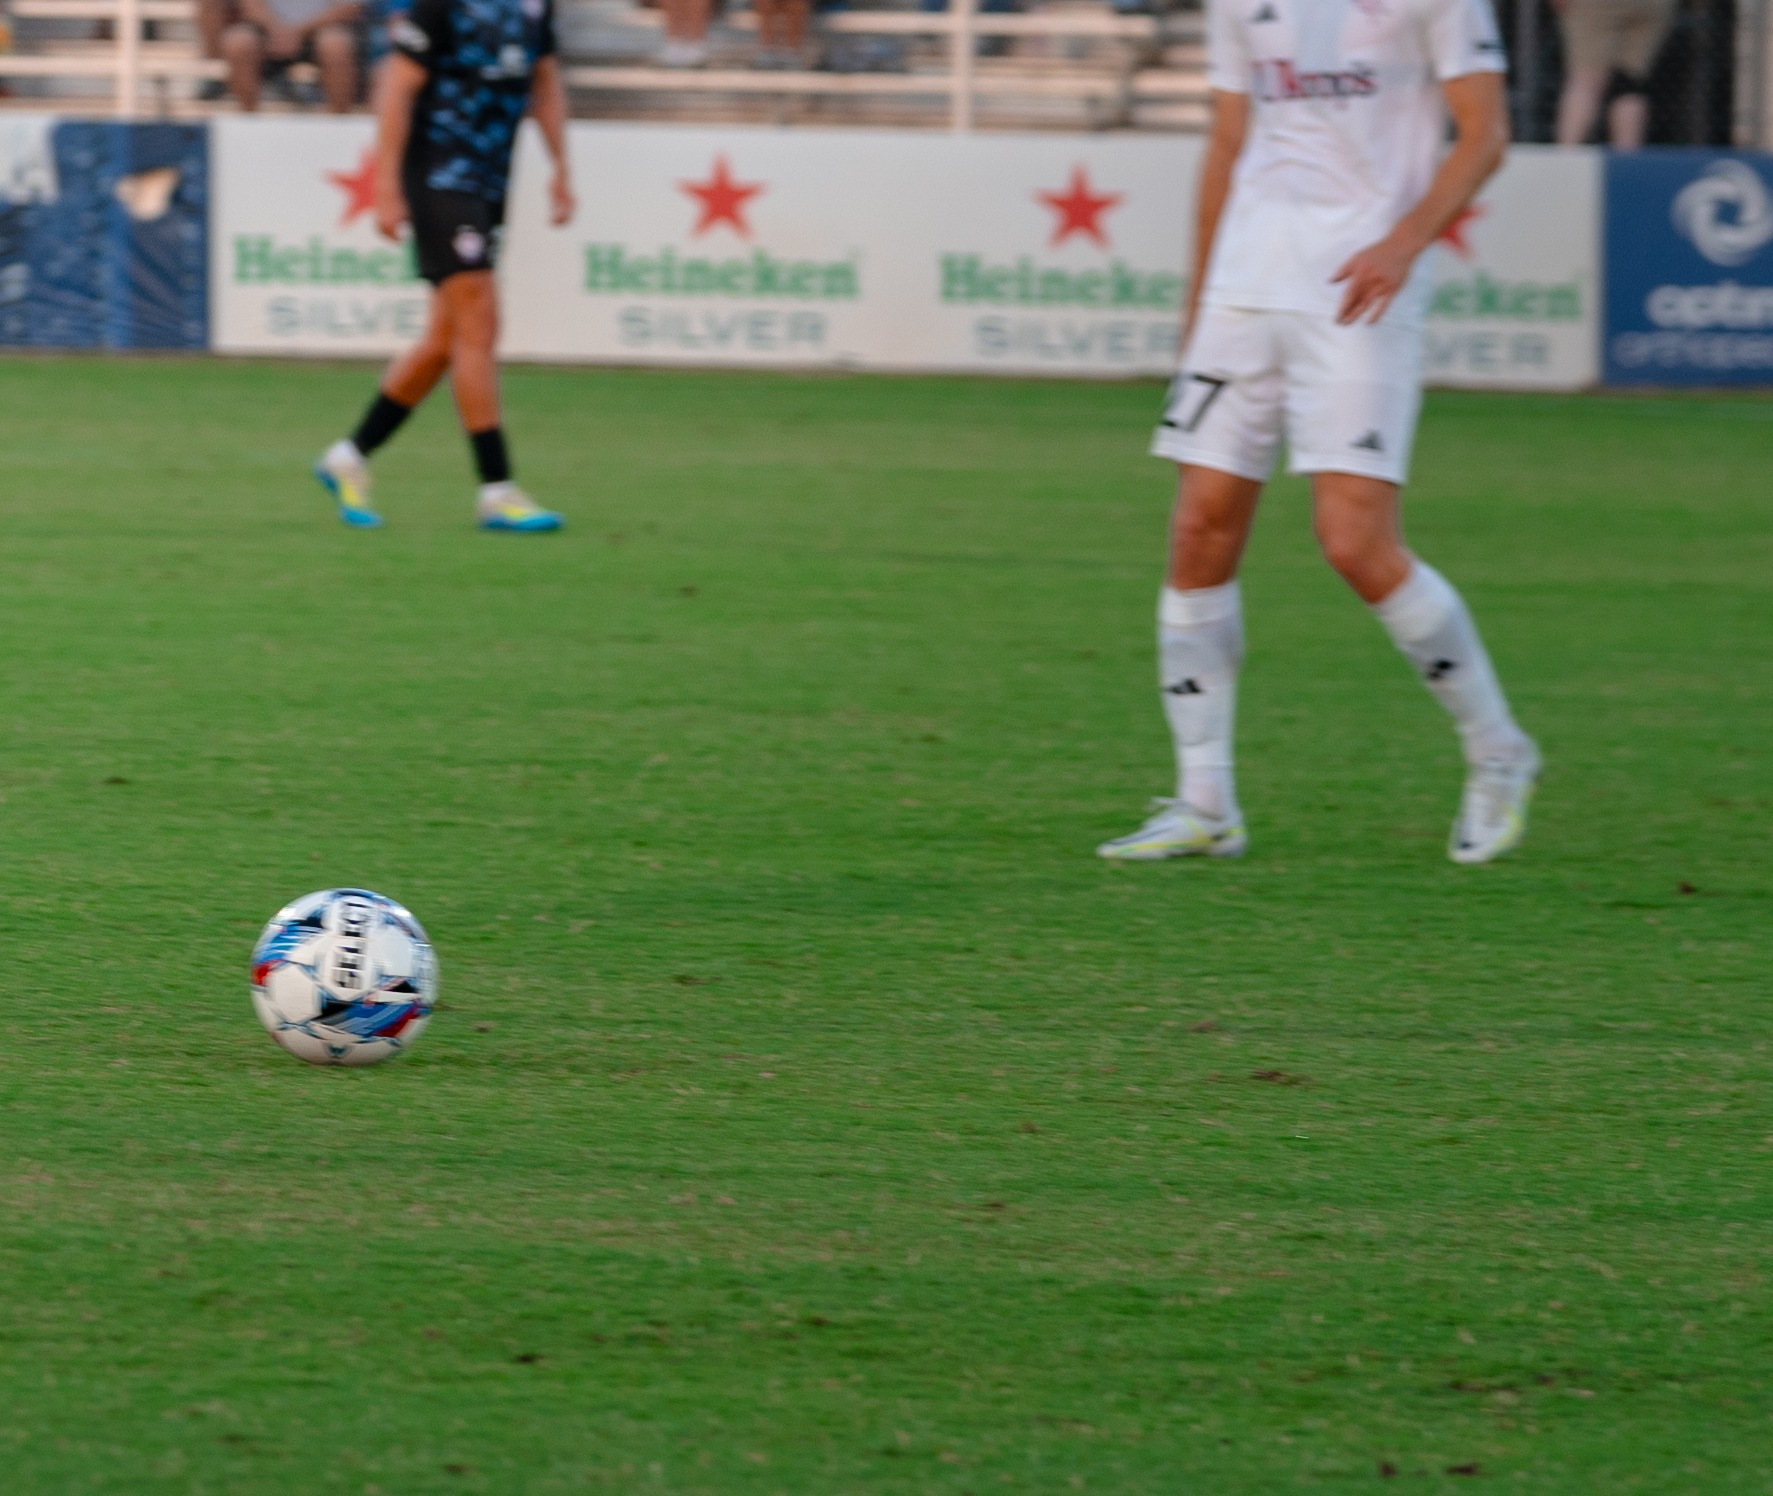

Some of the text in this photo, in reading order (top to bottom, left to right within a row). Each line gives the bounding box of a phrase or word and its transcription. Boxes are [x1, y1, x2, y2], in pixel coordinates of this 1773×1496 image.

[582, 243, 861, 300] Heineken
[939, 252, 1185, 311] Heineke
[267, 295, 427, 337] SILVE
[616, 305, 827, 351] SILVER
[332, 901, 373, 989] SELECT
